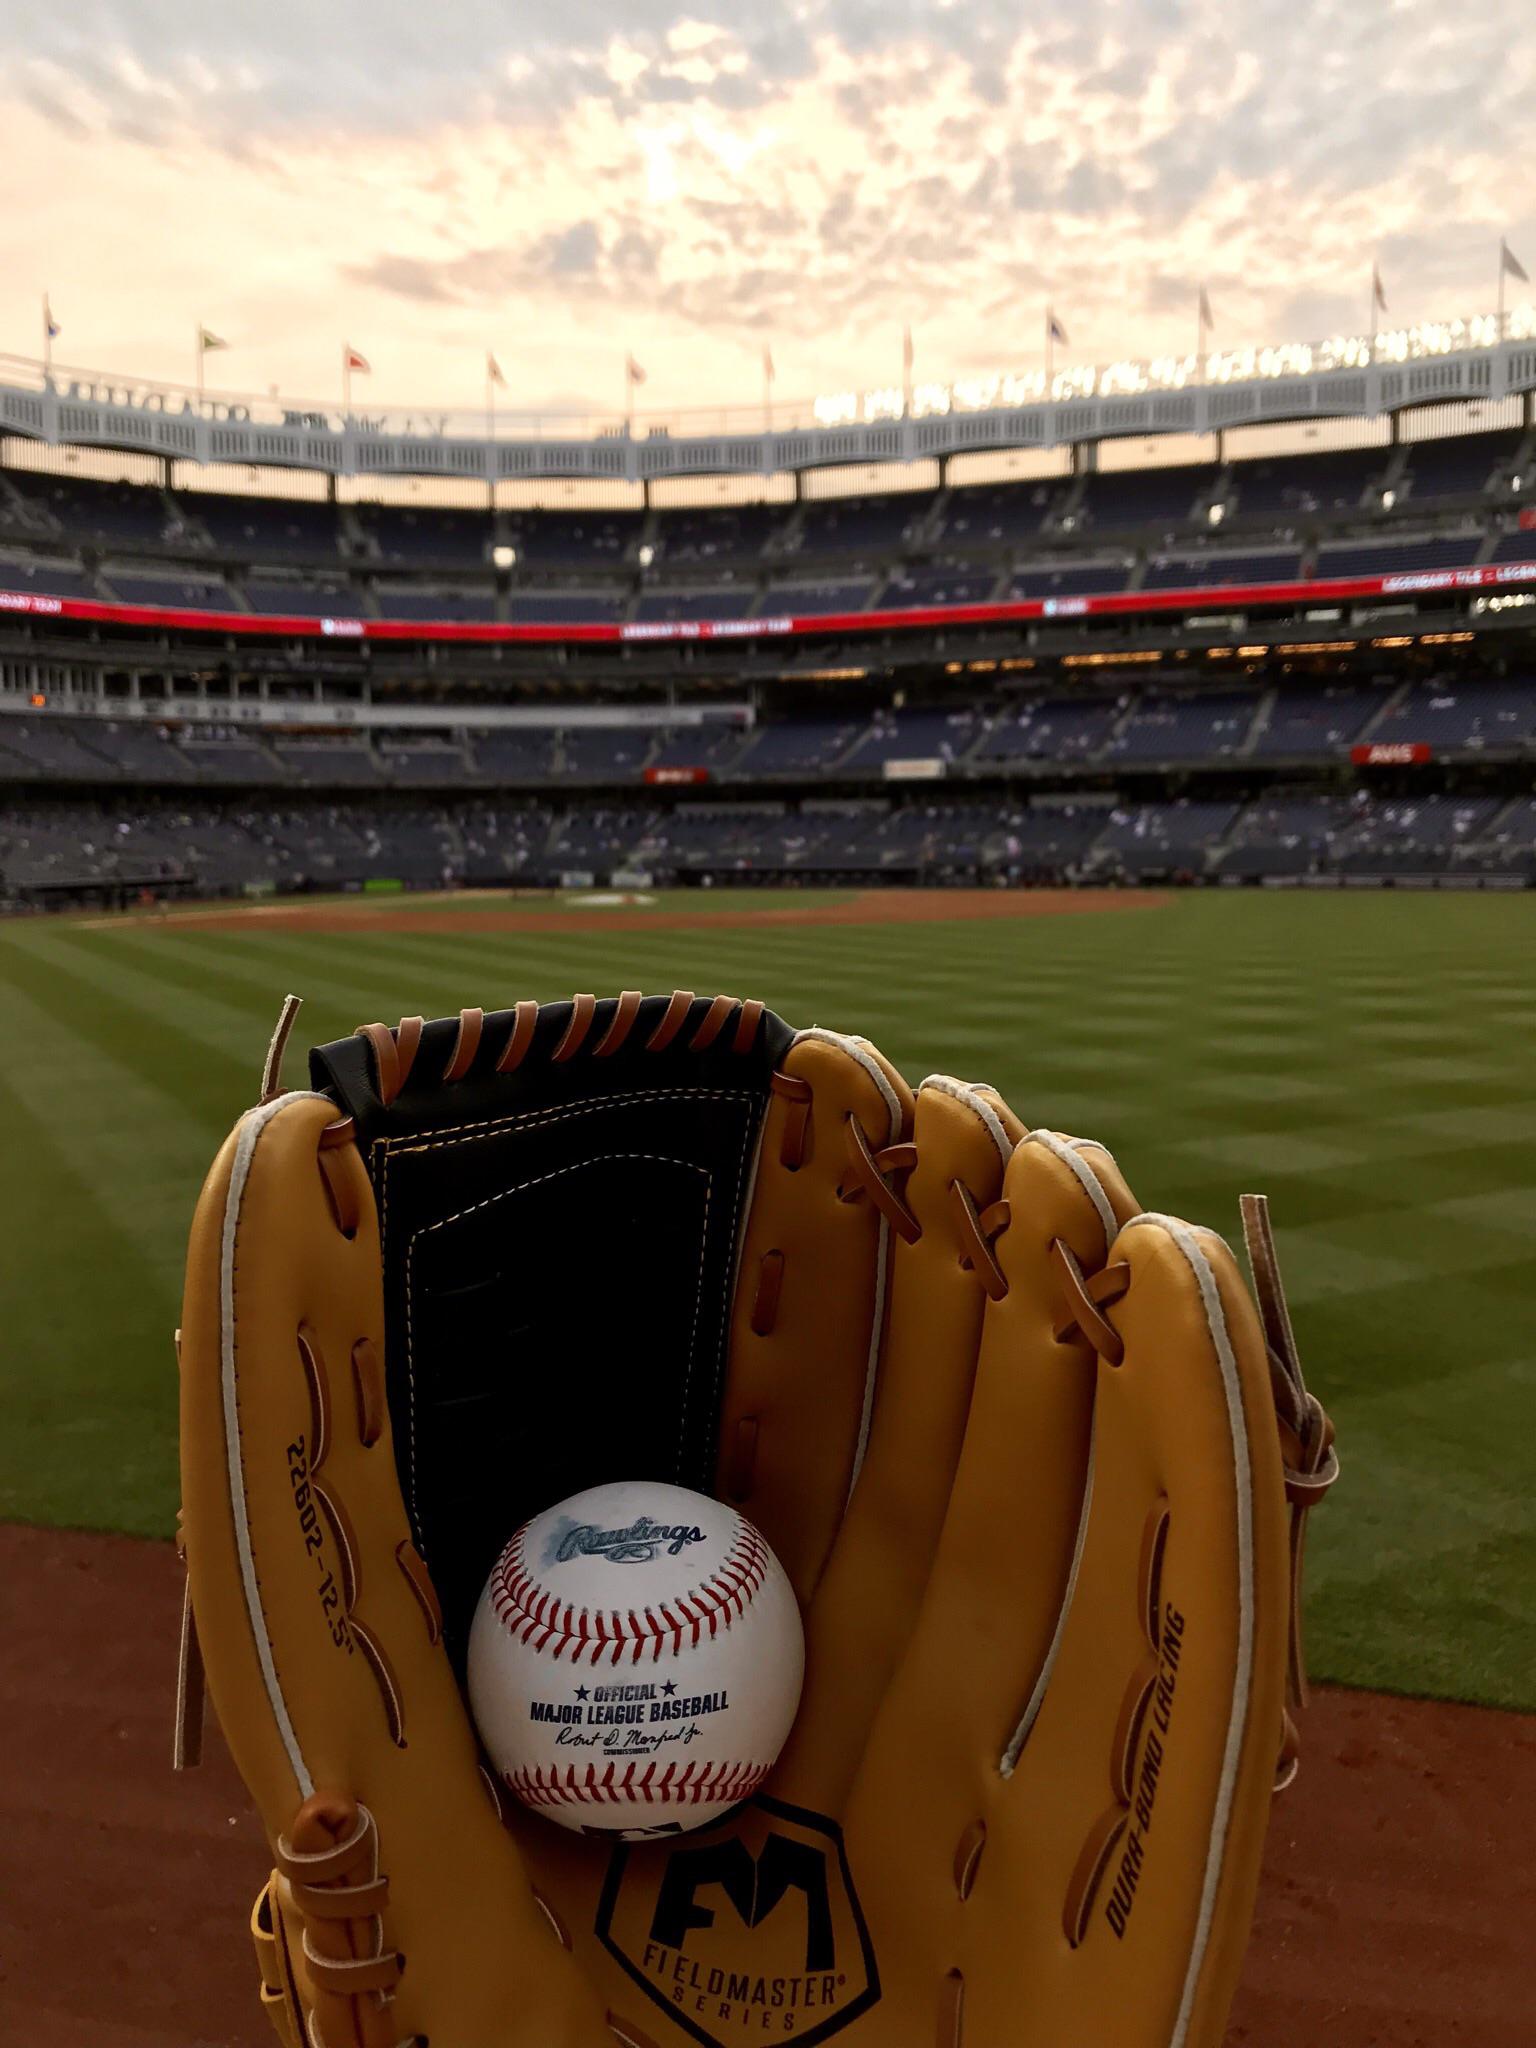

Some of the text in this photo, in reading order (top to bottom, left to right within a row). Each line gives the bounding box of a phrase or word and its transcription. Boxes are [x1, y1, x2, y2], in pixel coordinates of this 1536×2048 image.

[1368, 745, 1415, 762] AVIS
[556, 1516, 707, 1564] Rawlings
[1153, 1602, 1185, 1736] LACING
[530, 1690, 729, 1725] MAJOR LEAGUE BASEBALL
[593, 1683, 657, 1702] OFFICIAL
[642, 1943, 837, 2008] FIELDMASTER
[672, 1985, 795, 2031] SERIES
